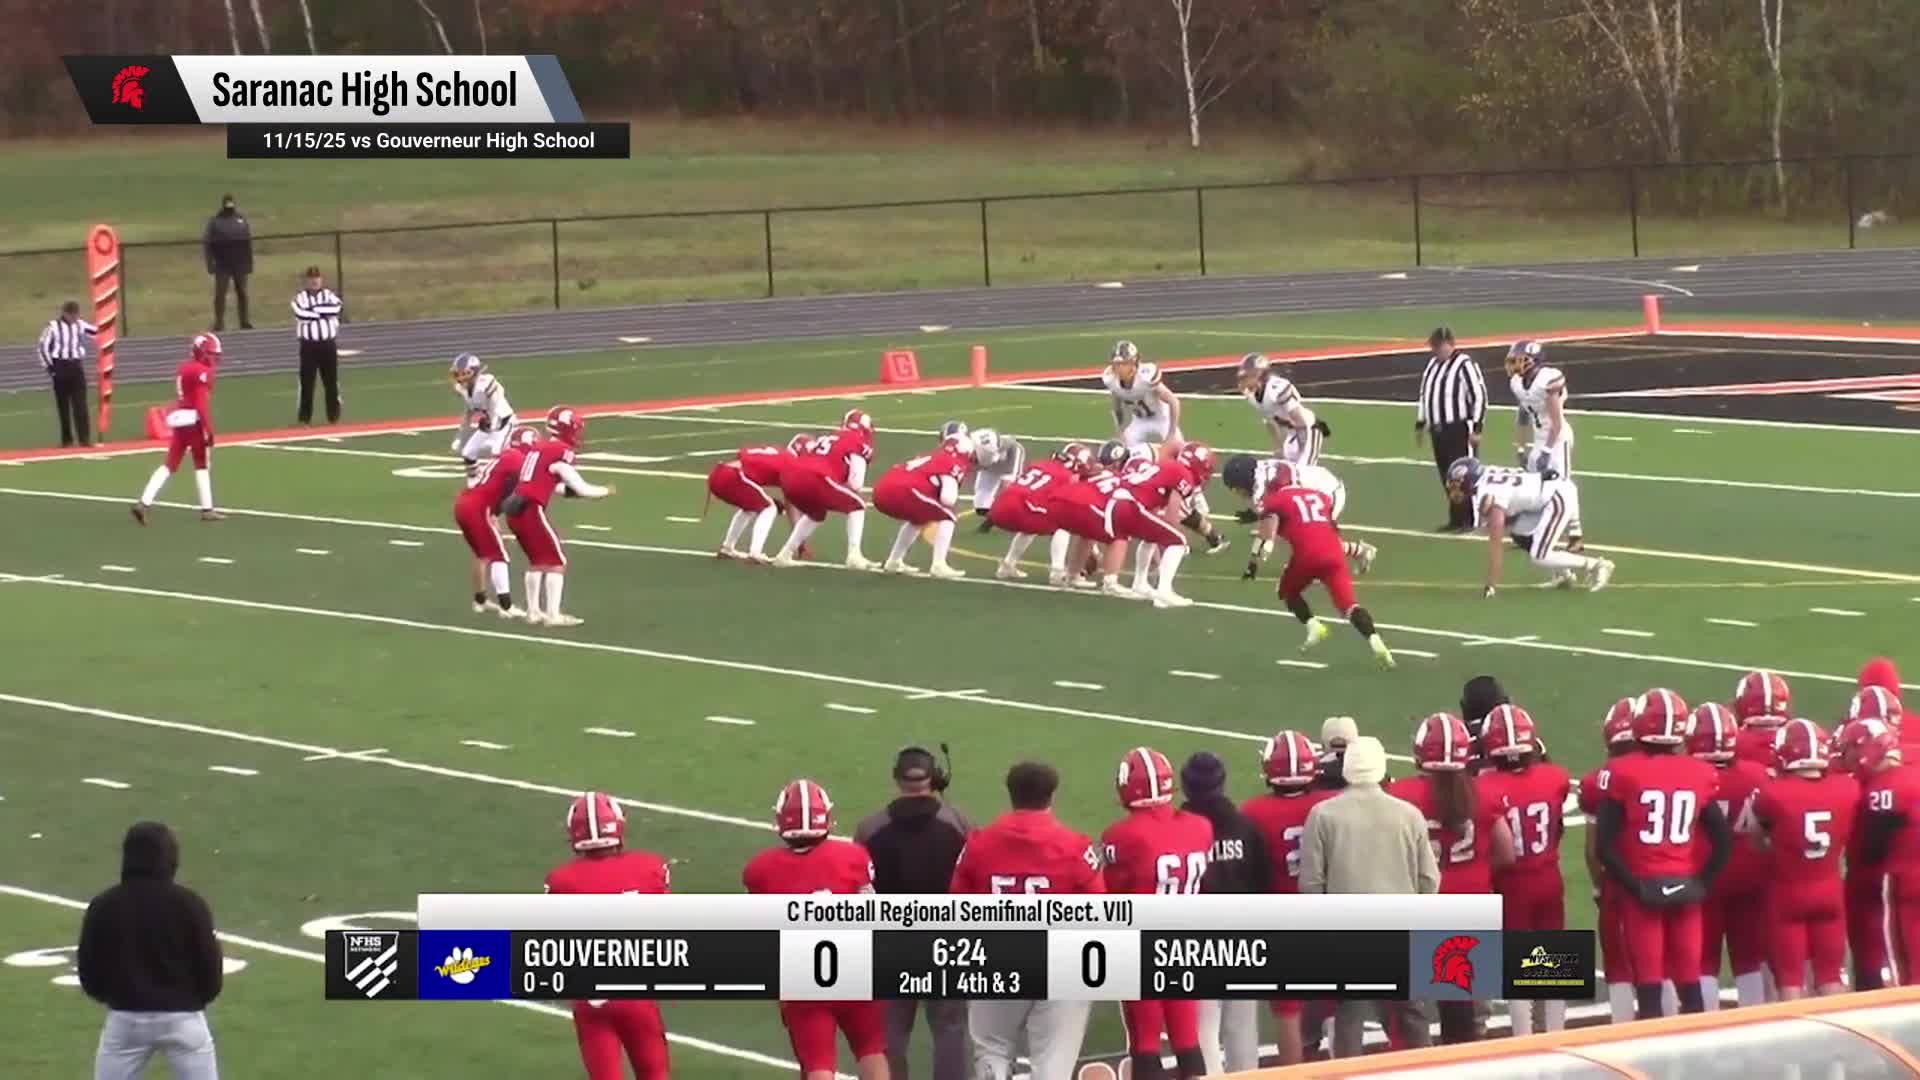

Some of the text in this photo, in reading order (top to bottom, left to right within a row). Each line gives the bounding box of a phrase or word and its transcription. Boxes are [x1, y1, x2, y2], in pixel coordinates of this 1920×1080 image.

[1292, 494, 1329, 523] 12
[1639, 789, 1697, 845] 30
[1869, 790, 1893, 811] 20
[1507, 801, 1550, 857] 13
[1803, 811, 1833, 859] 5
